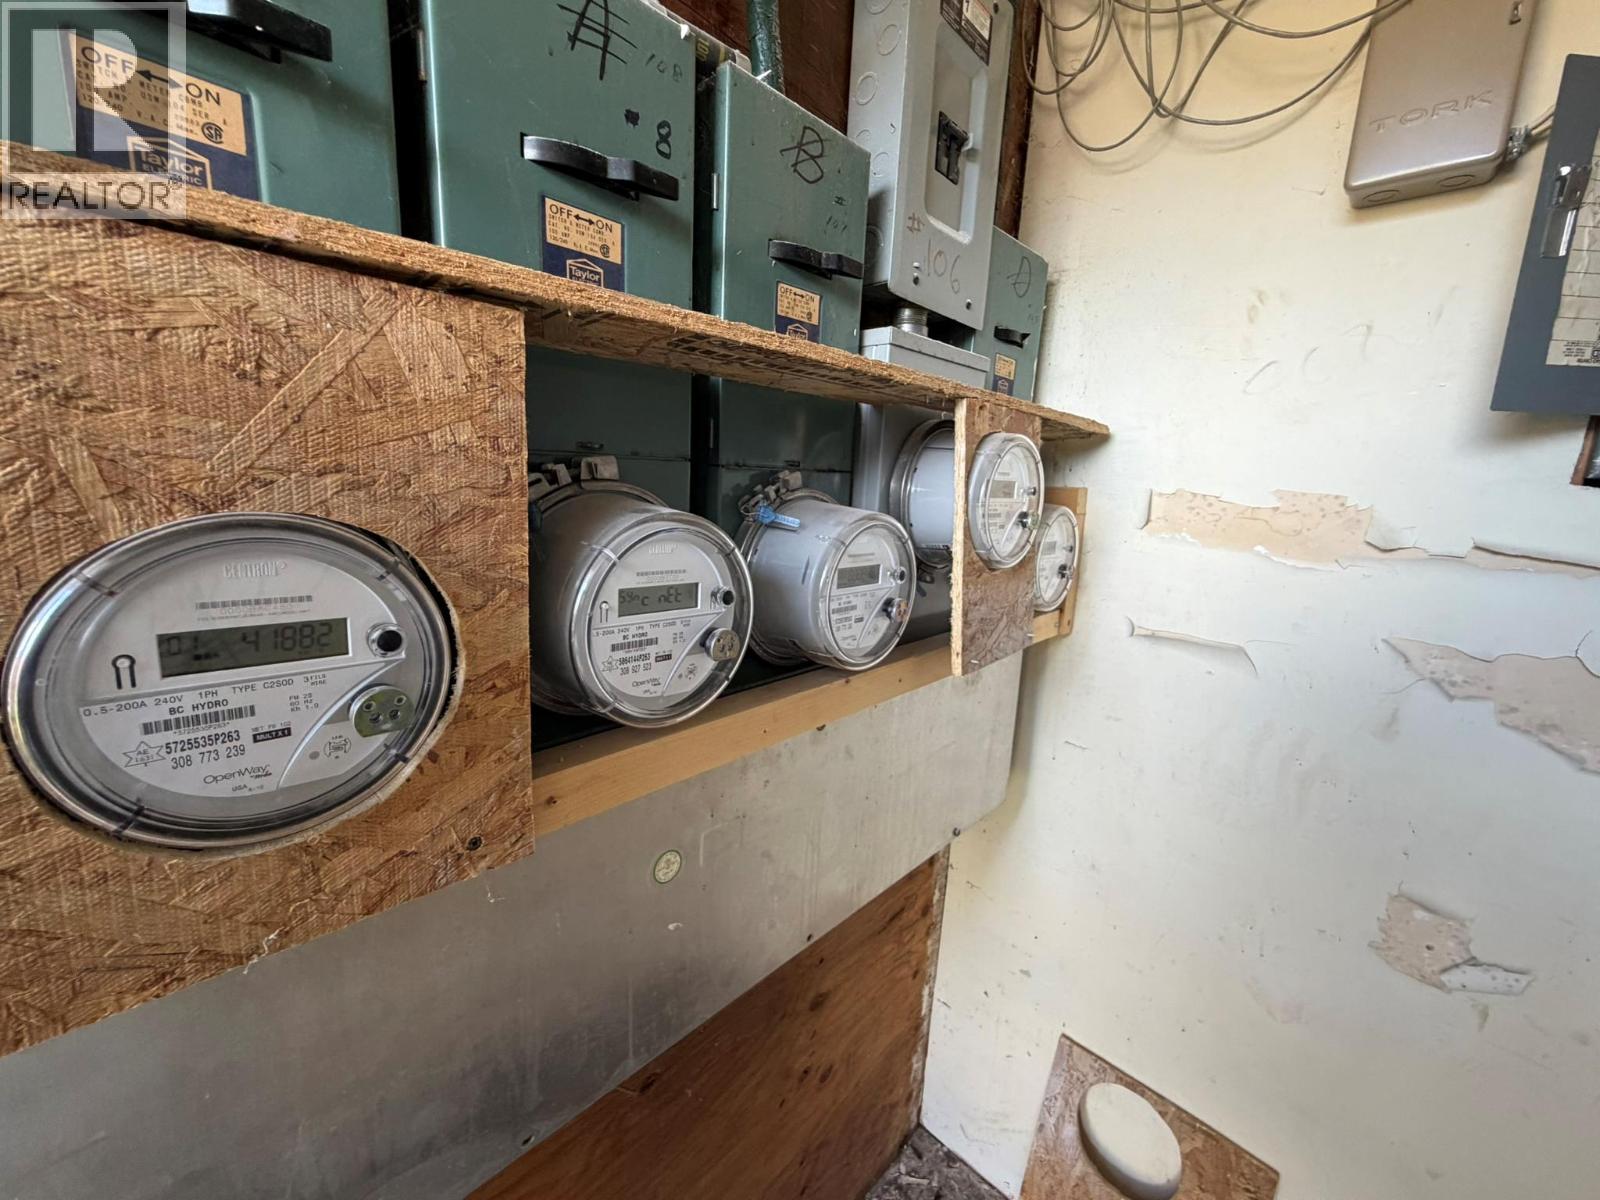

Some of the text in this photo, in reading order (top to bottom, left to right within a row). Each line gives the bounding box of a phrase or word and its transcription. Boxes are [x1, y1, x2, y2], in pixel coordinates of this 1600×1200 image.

[80, 46, 220, 106] OFF ON
[1369, 89, 1493, 133] TORK
[549, 204, 613, 233] OFF ON
[570, 266, 601, 282] Taylor
[927, 239, 961, 294] 106
[241, 623, 333, 653] 41882
[82, 699, 148, 718] 0.5-200A
[153, 694, 184, 707] 240V
[231, 683, 257, 695] TYPE
[168, 698, 229, 716] BC HYDRO
[164, 729, 240, 755] 5725535P263
[170, 744, 246, 769] 308 773 239
[203, 764, 269, 785] OpenWay
